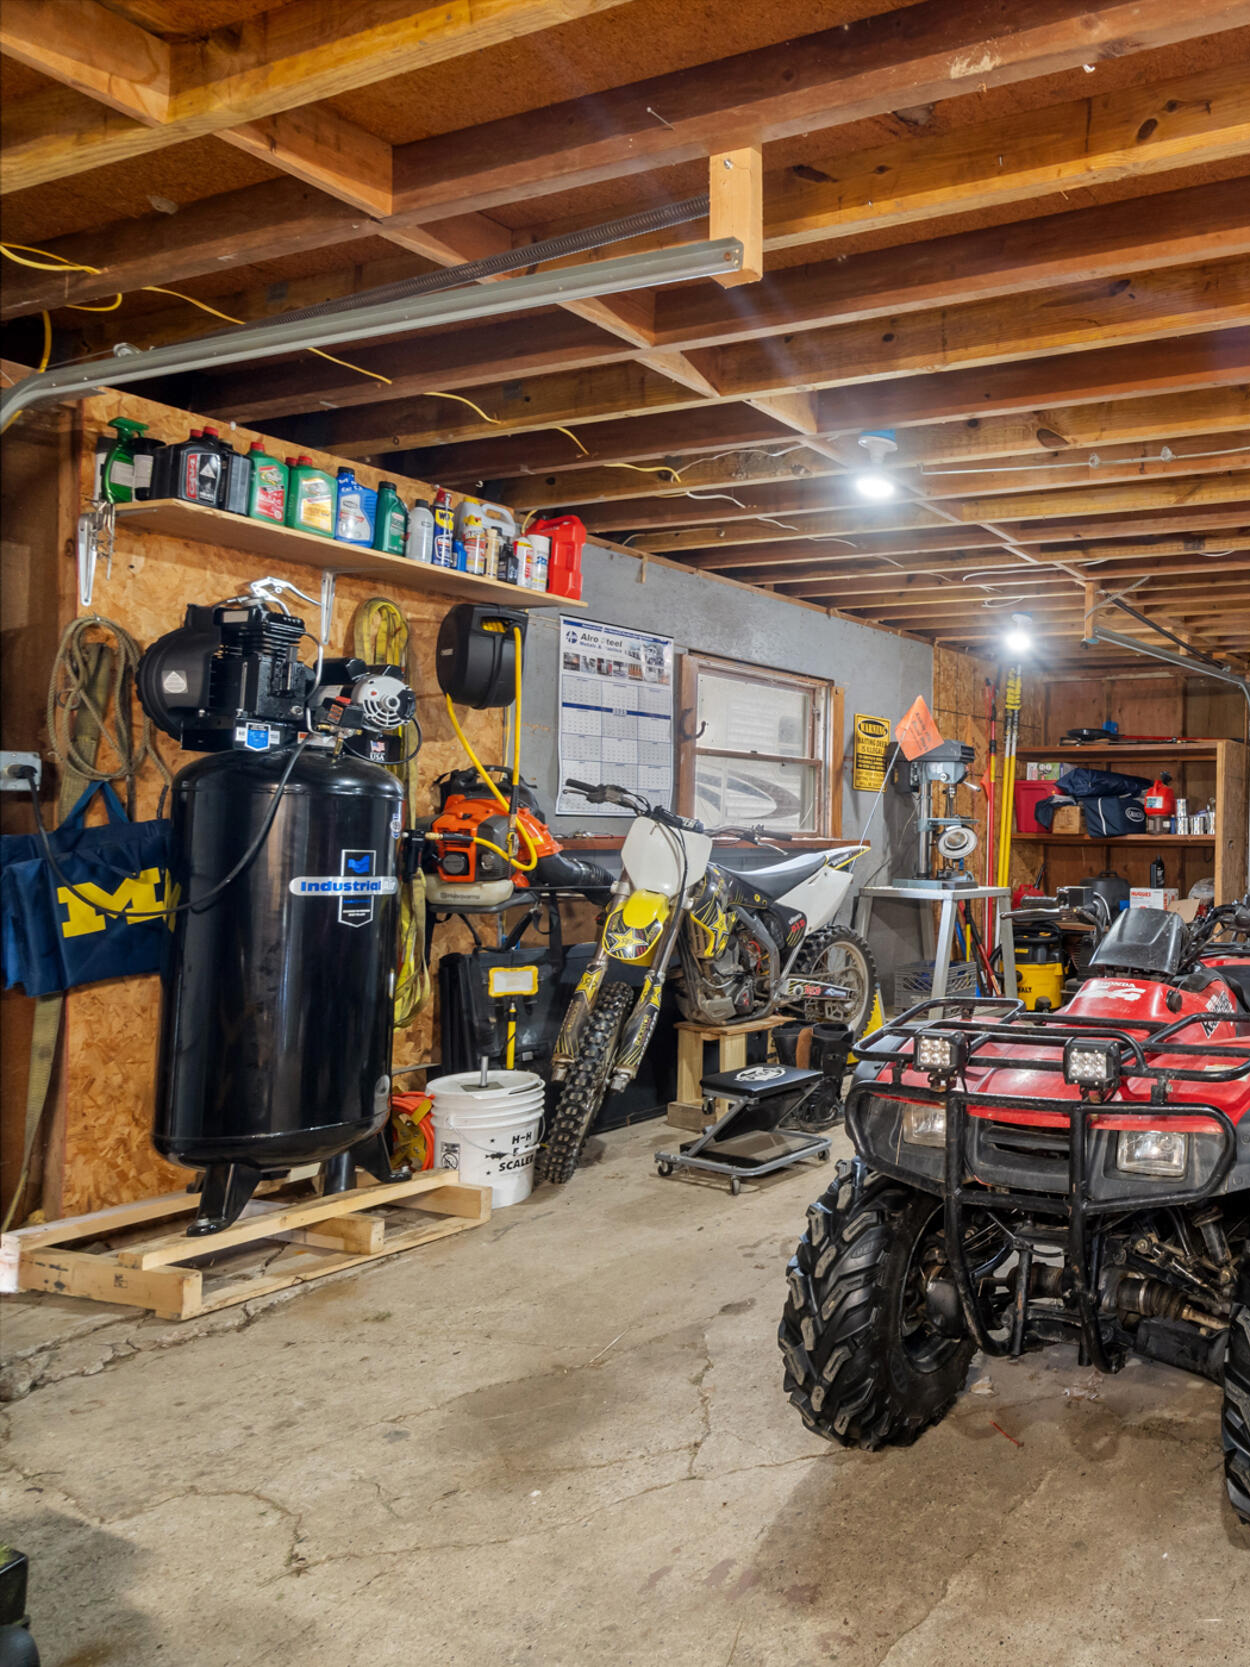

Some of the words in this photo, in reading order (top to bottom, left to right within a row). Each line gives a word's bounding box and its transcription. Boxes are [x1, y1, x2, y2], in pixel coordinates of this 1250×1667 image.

[580, 632, 599, 643] Alro
[370, 752, 385, 761] USA
[300, 880, 381, 892] Industrial
[1101, 980, 1136, 988] HONDA
